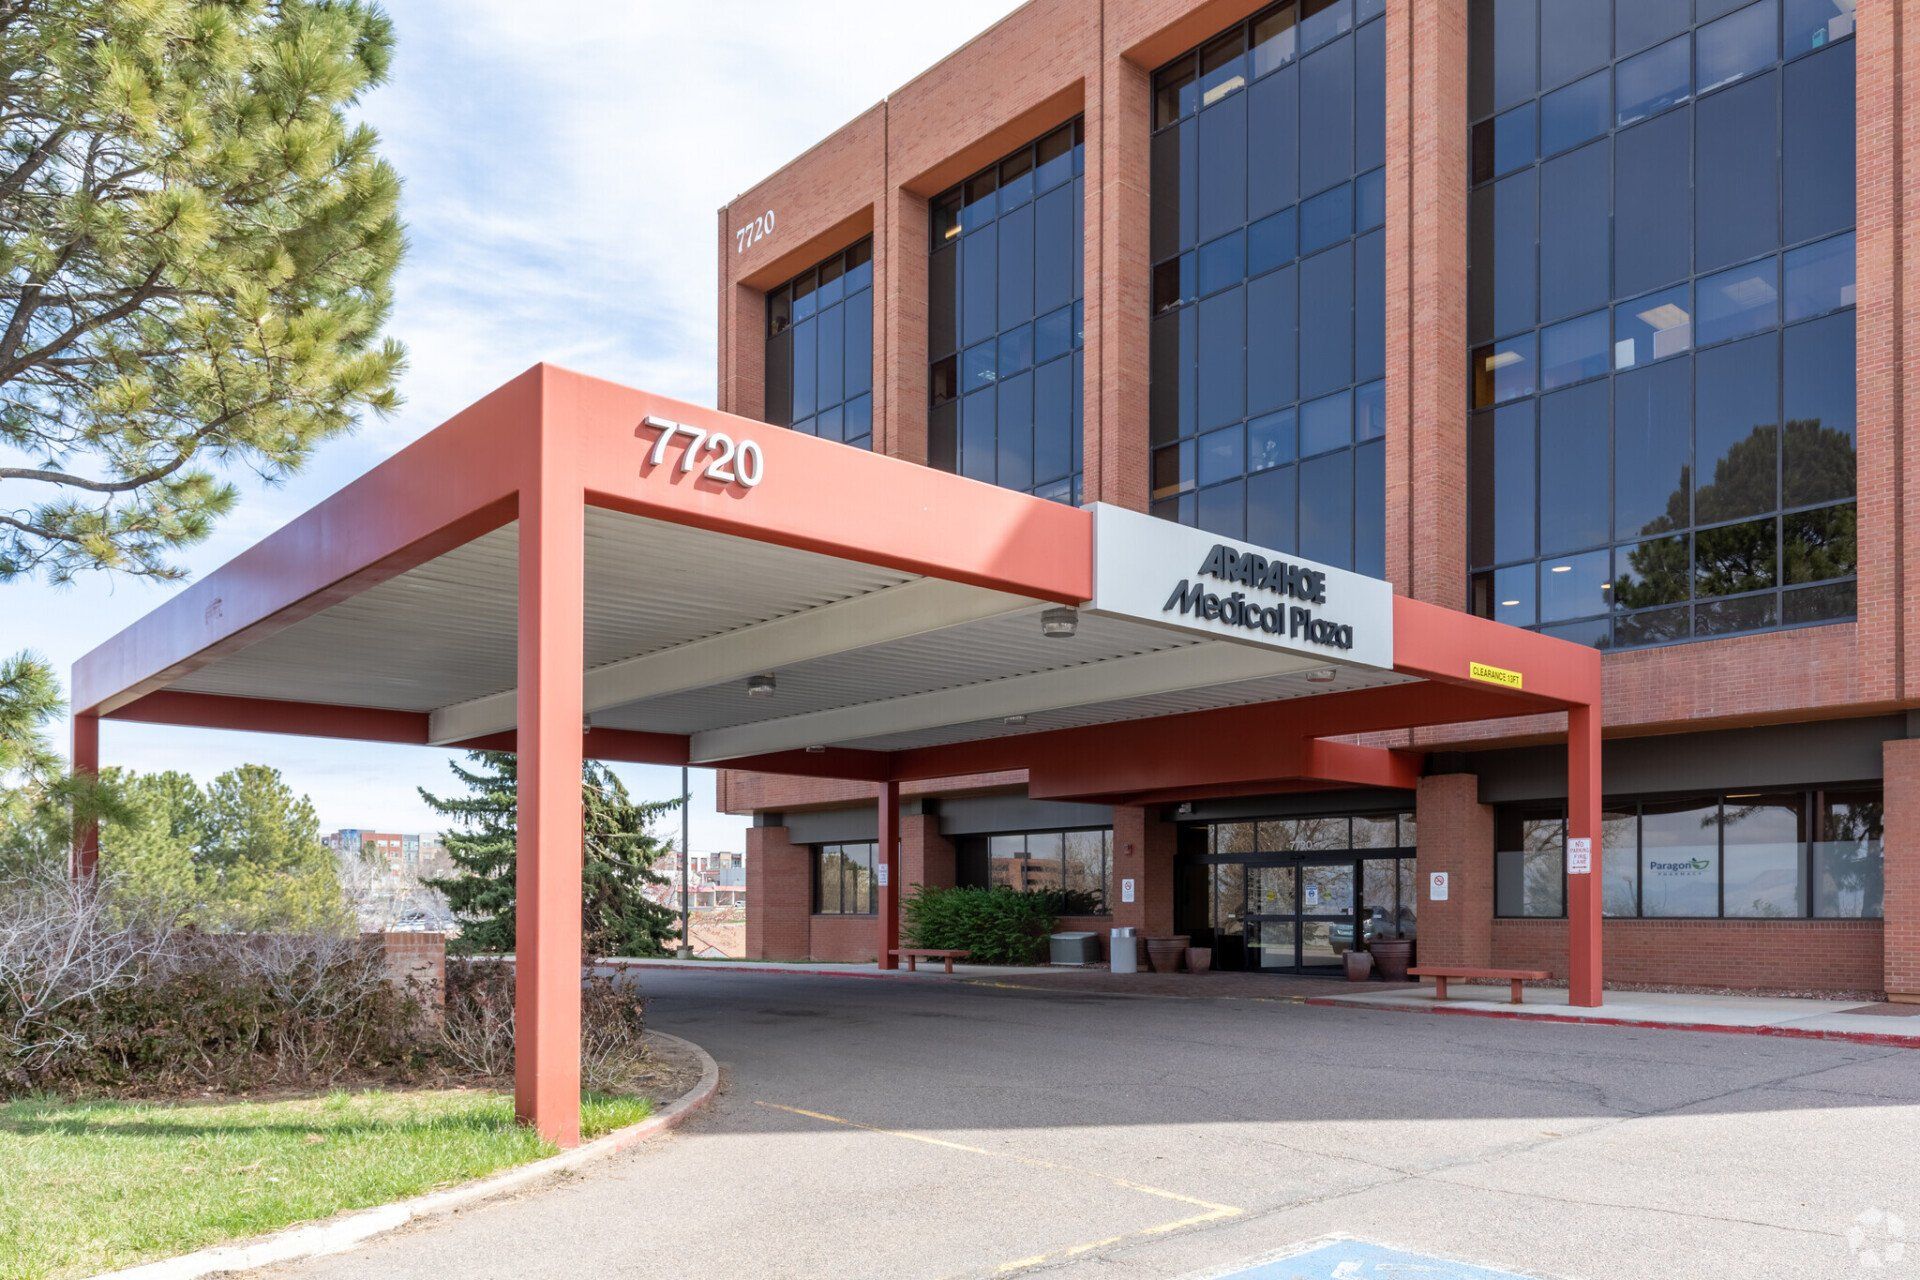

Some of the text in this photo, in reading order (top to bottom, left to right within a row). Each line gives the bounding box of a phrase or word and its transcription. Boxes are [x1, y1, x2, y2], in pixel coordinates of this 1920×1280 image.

[736, 209, 775, 253] 7720
[644, 415, 764, 488] 7720
[1197, 543, 1326, 605] ARAPAHOE
[1162, 579, 1354, 650] Medical Plaza
[1472, 666, 1506, 682] CLEARANCE
[1650, 861, 1692, 872] Paragon
